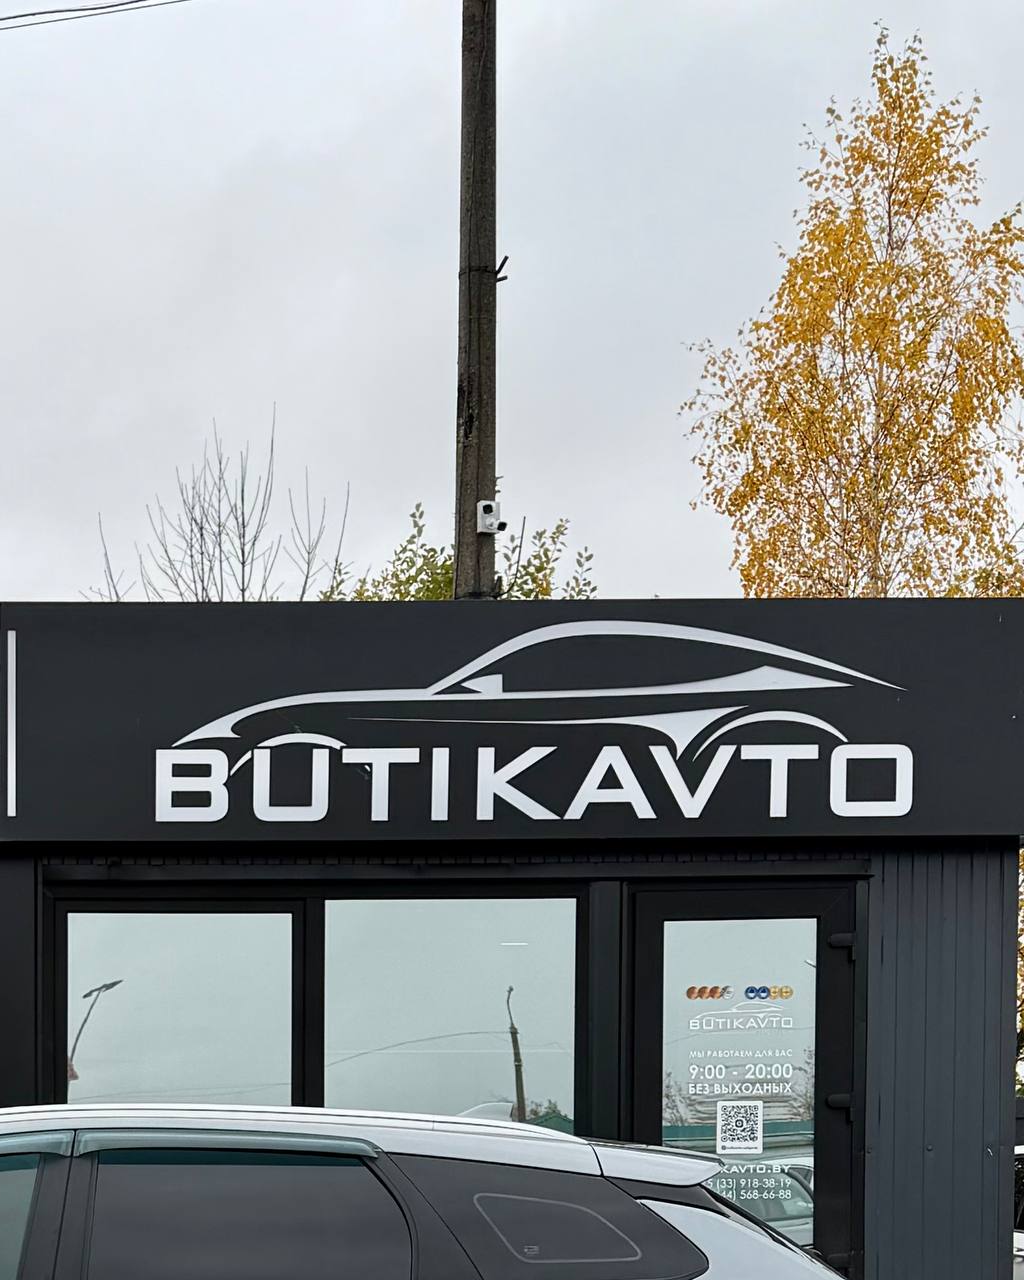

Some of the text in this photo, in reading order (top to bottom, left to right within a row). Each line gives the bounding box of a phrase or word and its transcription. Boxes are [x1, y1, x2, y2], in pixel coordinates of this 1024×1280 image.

[154, 743, 914, 823] BUTIKAVTO
[689, 1017, 793, 1029] BUTIKAVTO
[755, 1049, 773, 1057] ДЛЯ
[775, 1049, 793, 1057] ВАС
[689, 1064, 726, 1079] 9:00
[745, 1063, 793, 1079] 20:00
[688, 1082, 792, 1095] БЕЗ ВЫХОДНЫХ
[720, 1165, 791, 1173] KAVTO.BY
[717, 1179, 736, 1190] (33)
[739, 1178, 792, 1188] 918-38-19
[739, 1190, 792, 1200] 568-66-88
